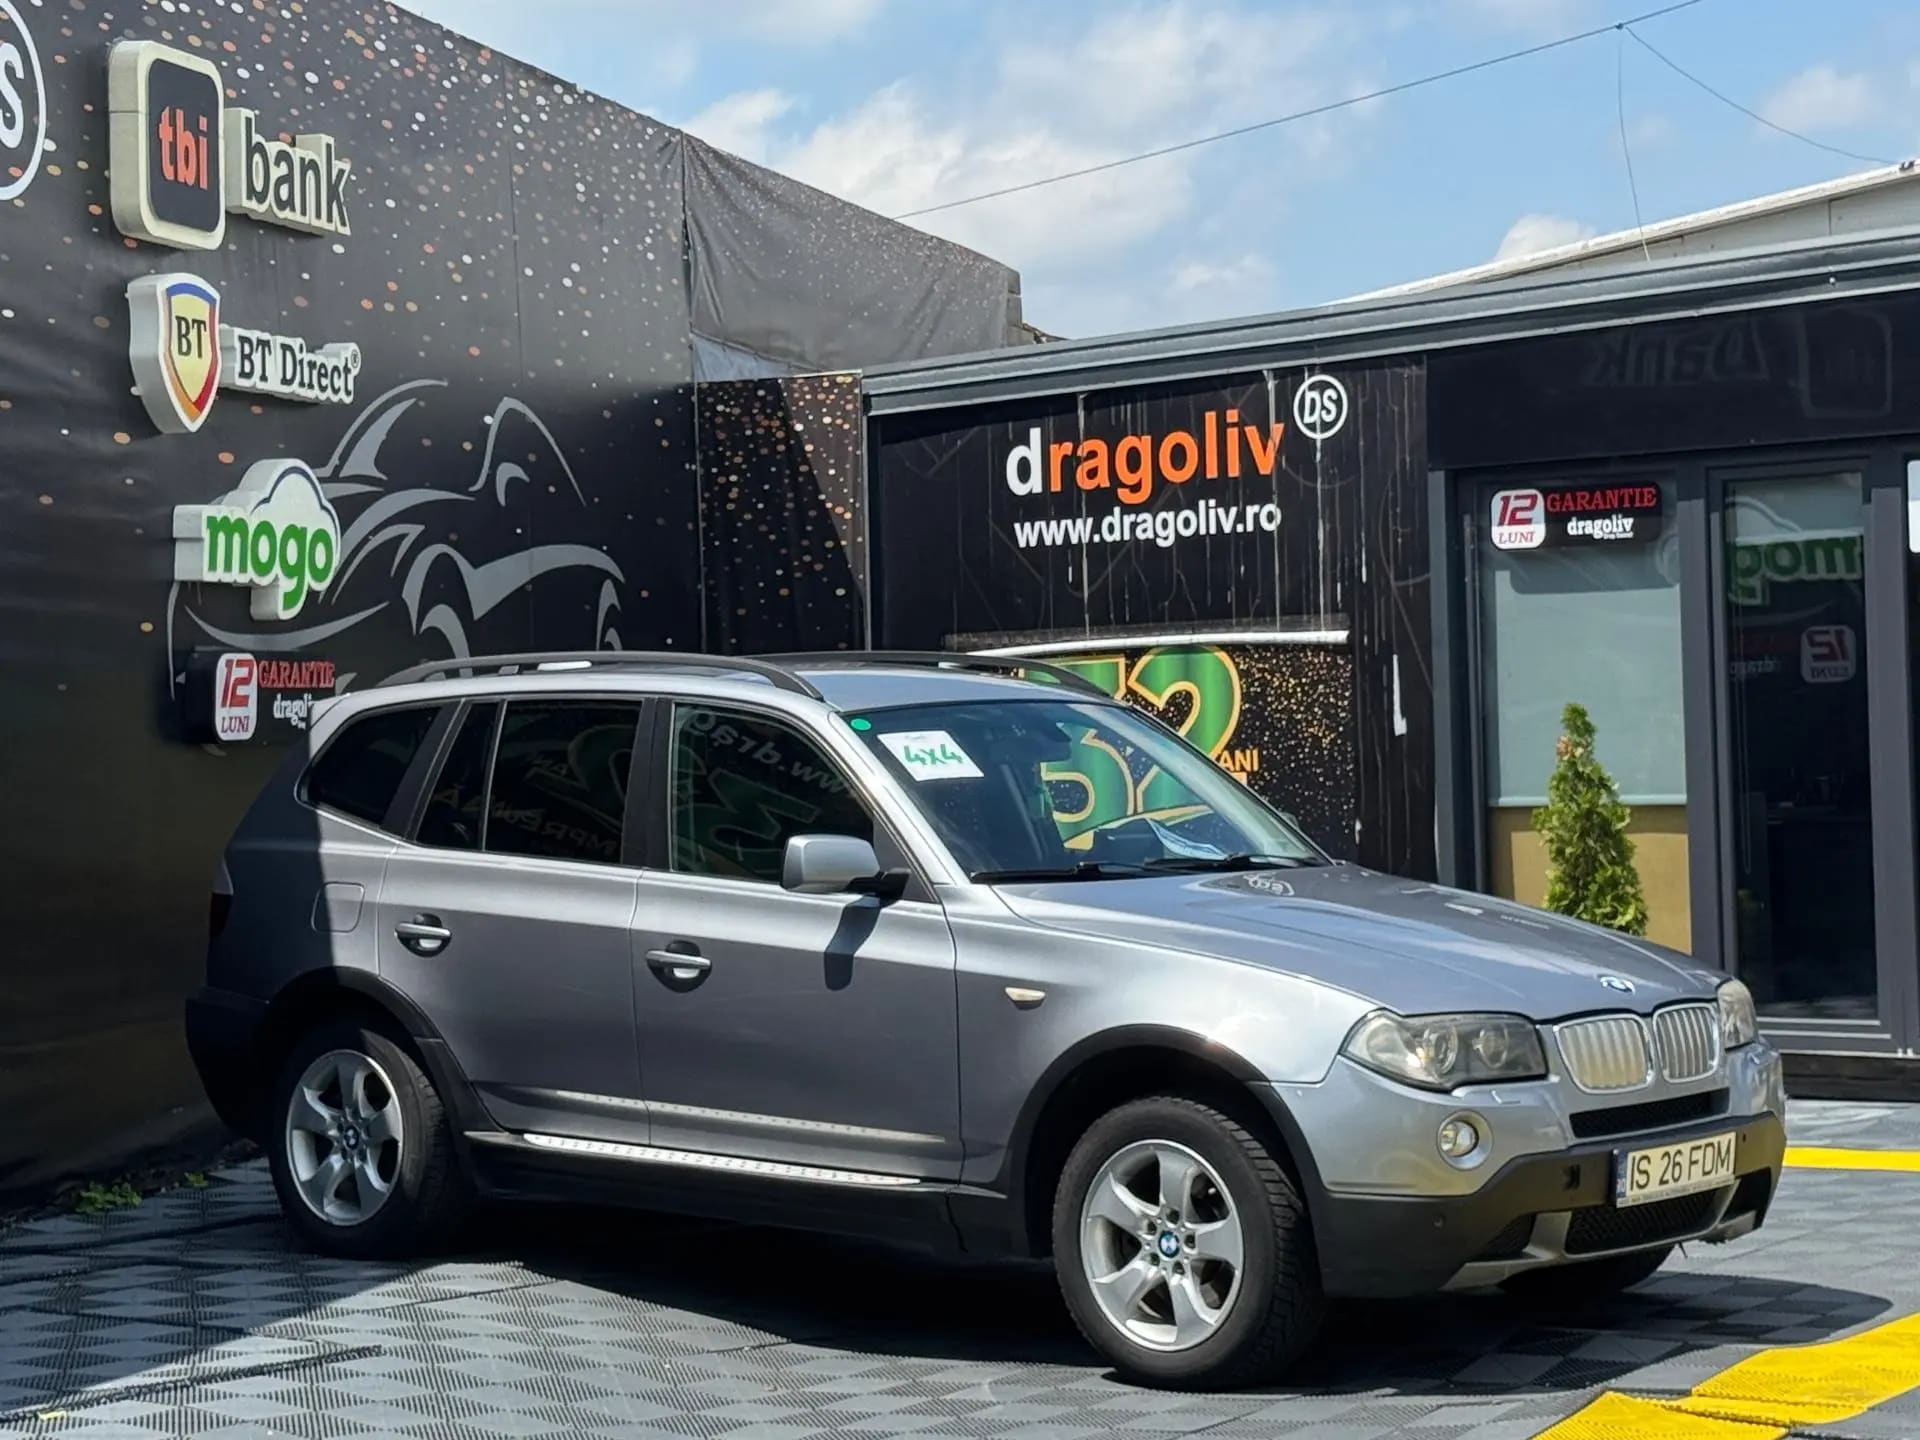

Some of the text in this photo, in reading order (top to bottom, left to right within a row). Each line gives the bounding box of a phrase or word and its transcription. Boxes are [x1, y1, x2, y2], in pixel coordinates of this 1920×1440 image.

[159, 106, 350, 228] tbi bank
[175, 315, 207, 358] BT
[238, 334, 272, 382] BT
[1303, 387, 1338, 424] DS
[1005, 409, 1285, 504] dragoliv
[1014, 499, 1282, 548] www.dragoliv.ro
[1497, 487, 1657, 526] 12 GARANTIE
[1567, 514, 1634, 539] dragoliv
[1498, 531, 1535, 545] LUNI
[206, 515, 334, 611] mogo
[222, 659, 335, 708] 12 GARANTIE
[221, 715, 250, 734] LUNI
[273, 692, 313, 726] dragol
[1218, 747, 1259, 772] ANI
[1630, 1155, 1651, 1191] IS
[1658, 1151, 1683, 1186] 26
[1687, 1139, 1732, 1181] FDM
